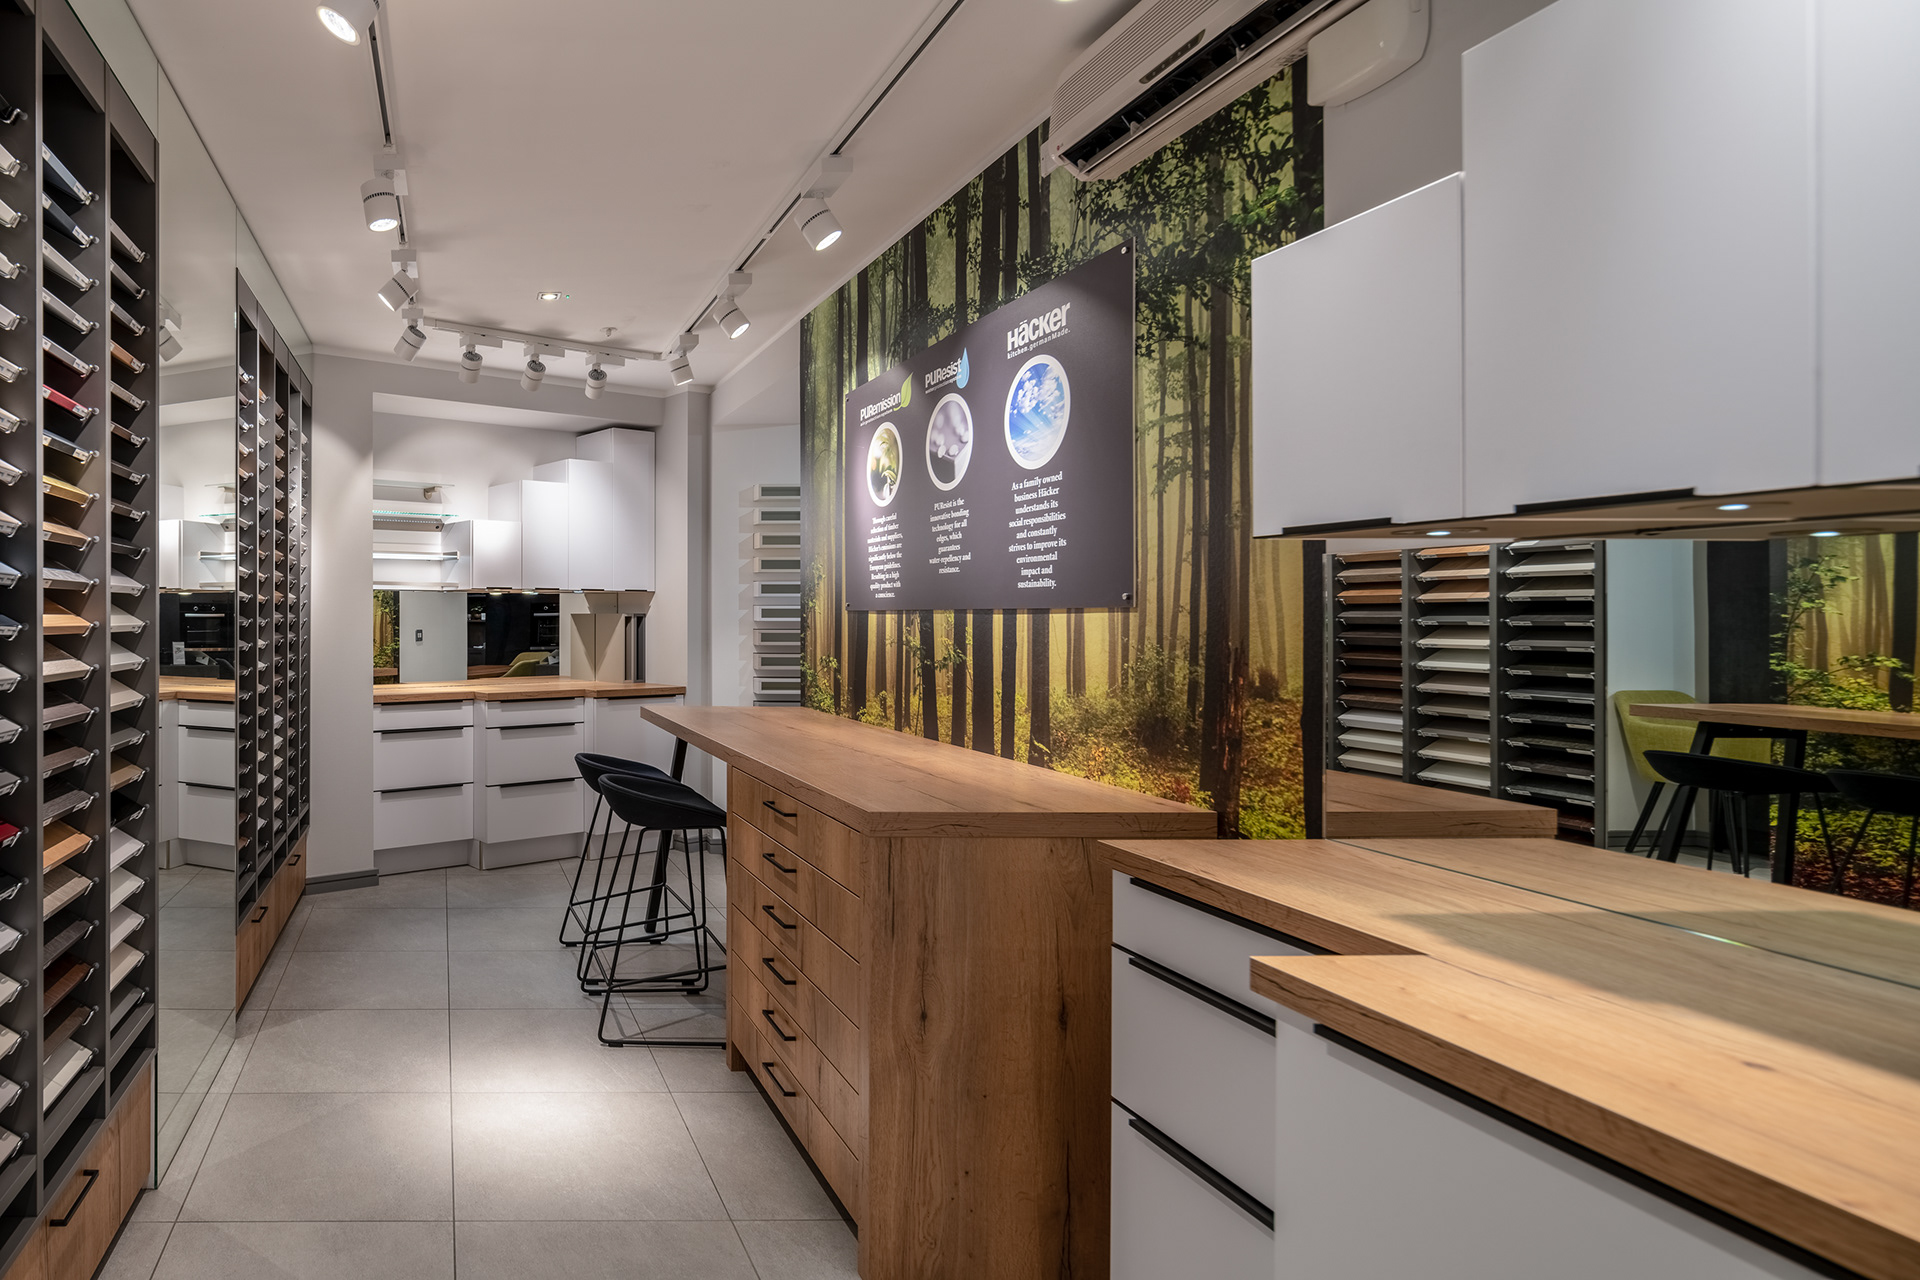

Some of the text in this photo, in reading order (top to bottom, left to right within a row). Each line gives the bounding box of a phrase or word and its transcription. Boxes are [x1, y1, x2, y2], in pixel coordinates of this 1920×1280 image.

[1007, 302, 1071, 352] Häcker
[925, 357, 962, 388] PUResist
[860, 392, 901, 421] PURemission
[1011, 482, 1018, 490] As
[1024, 476, 1042, 488] family
[1042, 471, 1062, 484] owned
[956, 498, 964, 506] the
[1014, 492, 1038, 502] business
[1016, 500, 1058, 514] understands its
[1009, 512, 1066, 528] social responsibilities
[1016, 525, 1057, 538] and constantly
[1009, 538, 1066, 552] strives to improve its
[1016, 551, 1058, 564] environmental
[1021, 564, 1052, 578] impact and
